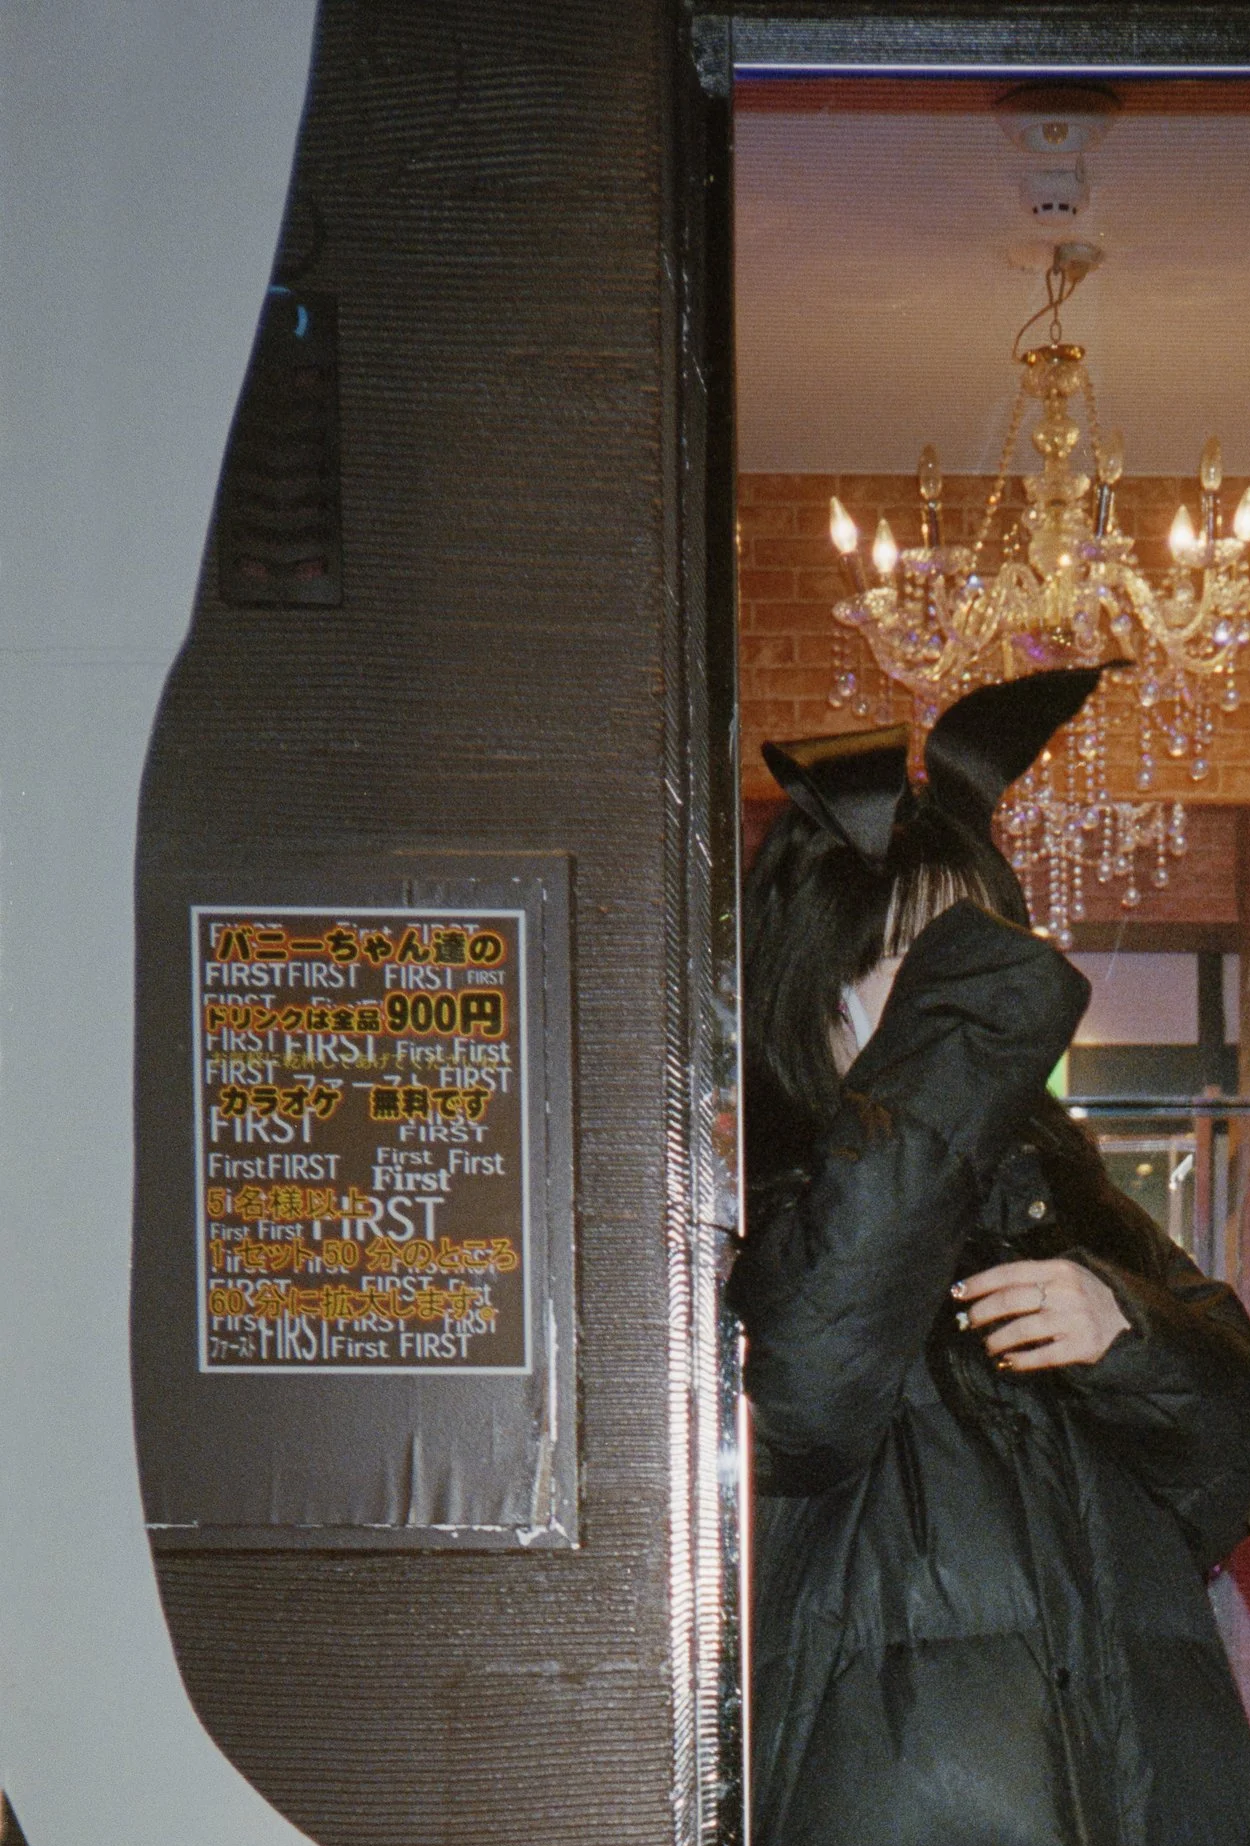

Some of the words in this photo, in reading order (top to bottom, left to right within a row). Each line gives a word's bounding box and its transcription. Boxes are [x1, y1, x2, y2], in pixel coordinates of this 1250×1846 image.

[385, 990, 504, 1037] 900円
[220, 1085, 343, 1120] カラオケ
[370, 1085, 491, 1121] 無料です
[449, 1149, 507, 1175] First
[371, 1165, 453, 1192] First
[331, 1335, 390, 1358] First
[400, 1332, 474, 1358] FIRST
